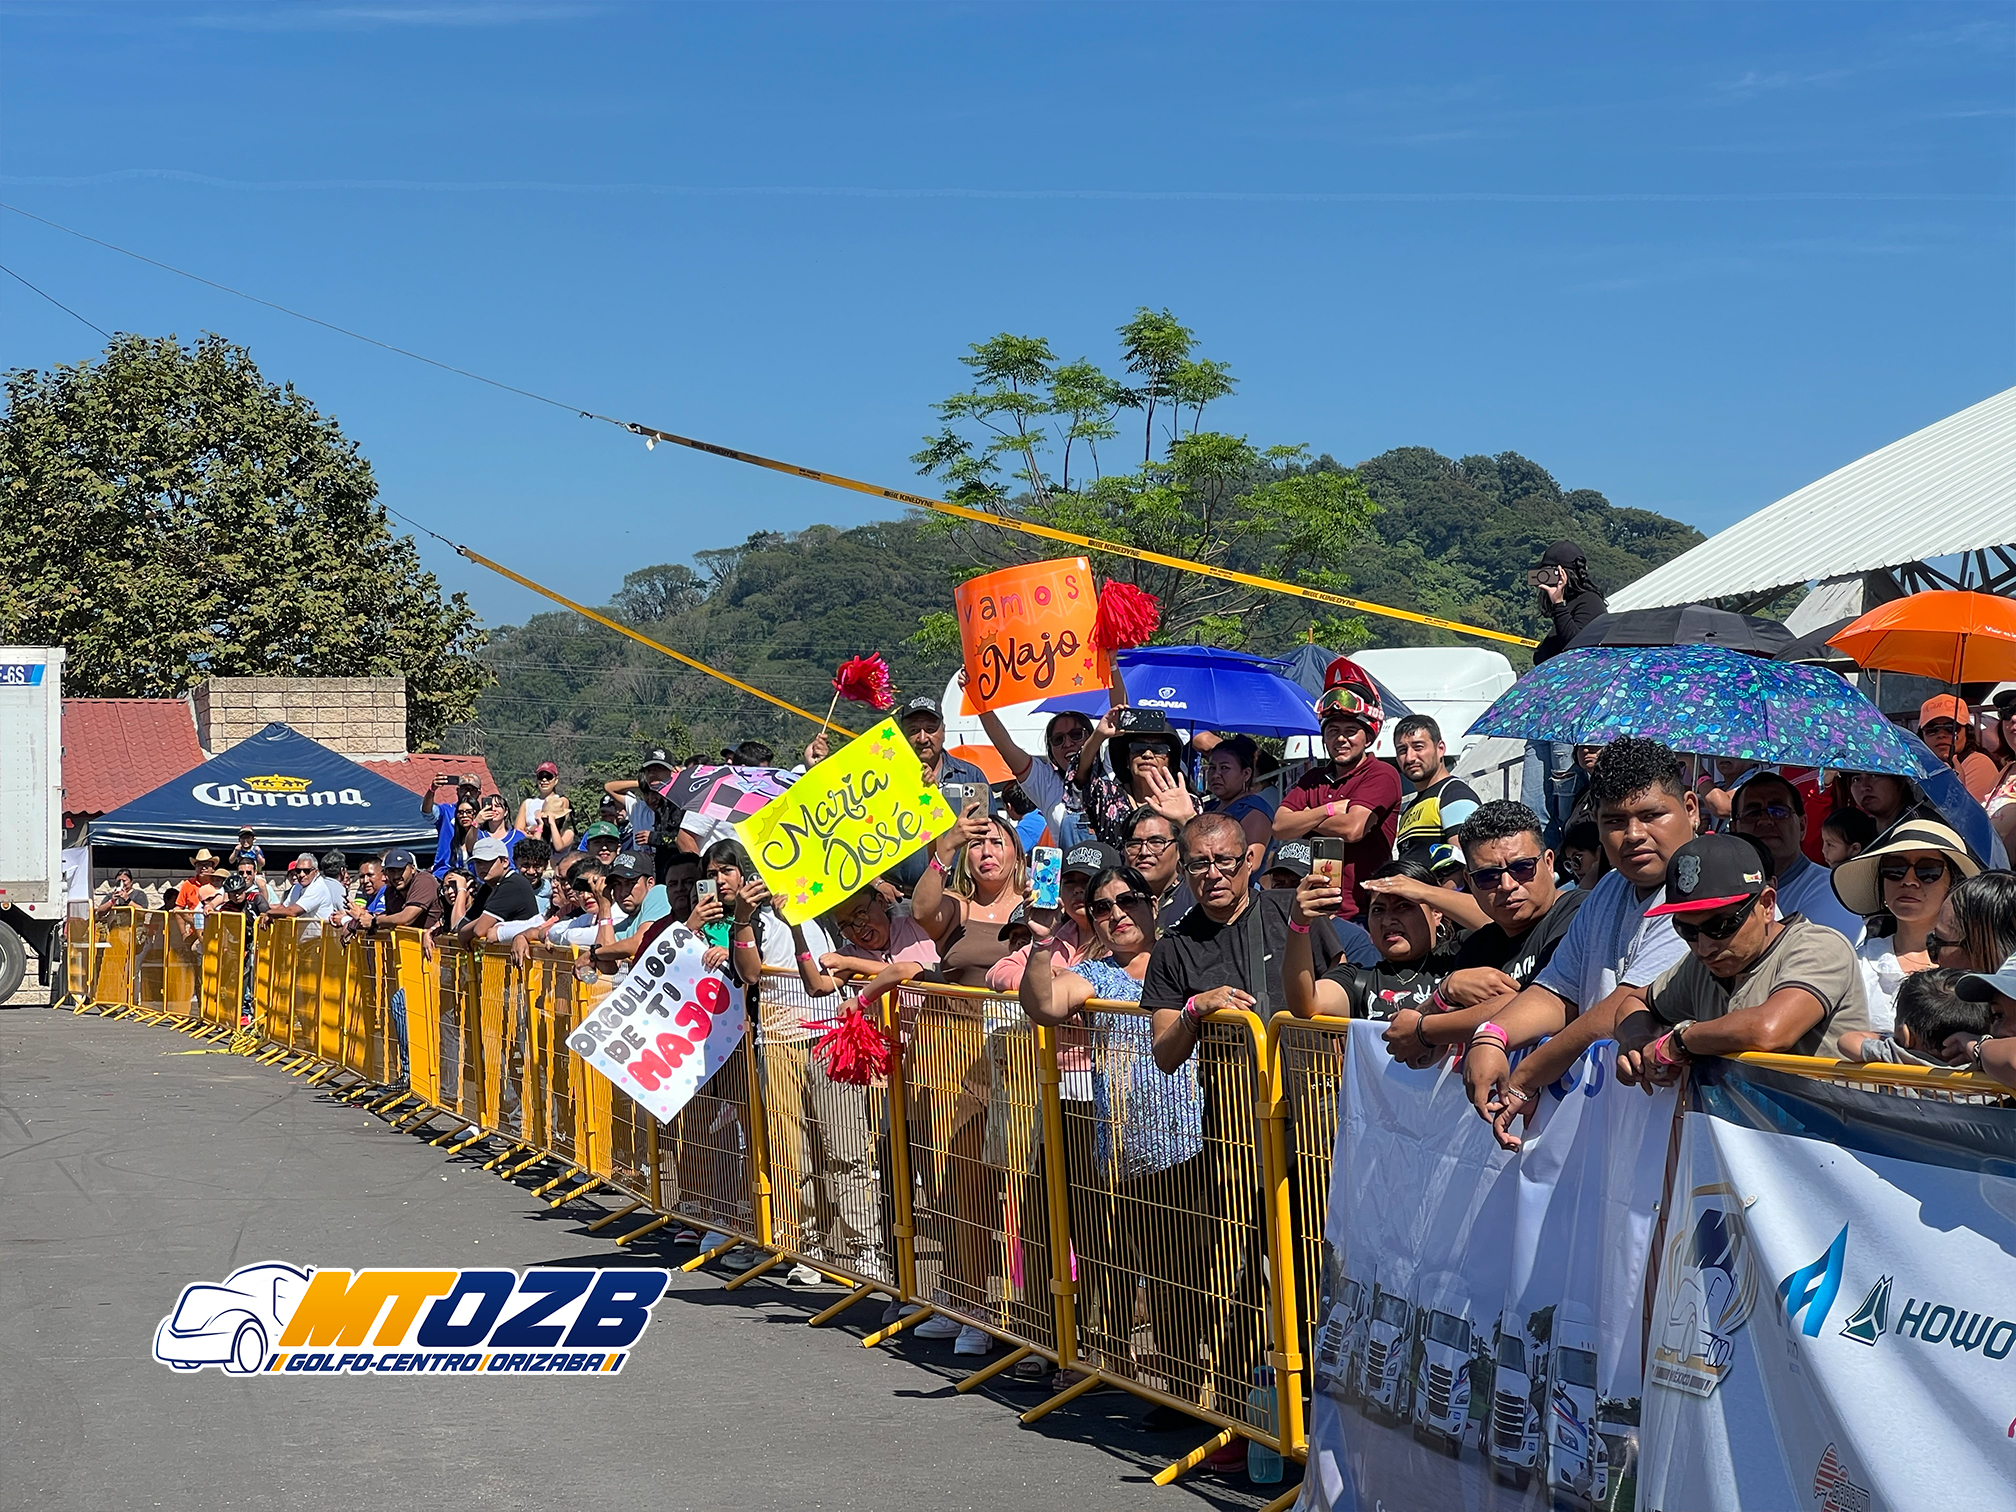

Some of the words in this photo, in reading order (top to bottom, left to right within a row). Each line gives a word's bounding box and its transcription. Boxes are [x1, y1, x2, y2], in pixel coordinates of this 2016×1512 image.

[899, 493, 935, 508] KINEDYNE
[1104, 543, 1141, 557] KINEDYNE
[1319, 593, 1357, 607] KINEDYNE
[978, 629, 1080, 701] Majo
[1137, 699, 1187, 709] SCANIA
[192, 782, 366, 811] Corona
[822, 801, 922, 892] José
[571, 928, 694, 1058] ORGULLOSA
[604, 1025, 647, 1065] DE
[645, 982, 682, 1019] TI
[627, 977, 730, 1091] MAJO
[1895, 1298, 2016, 1360] HOWO
